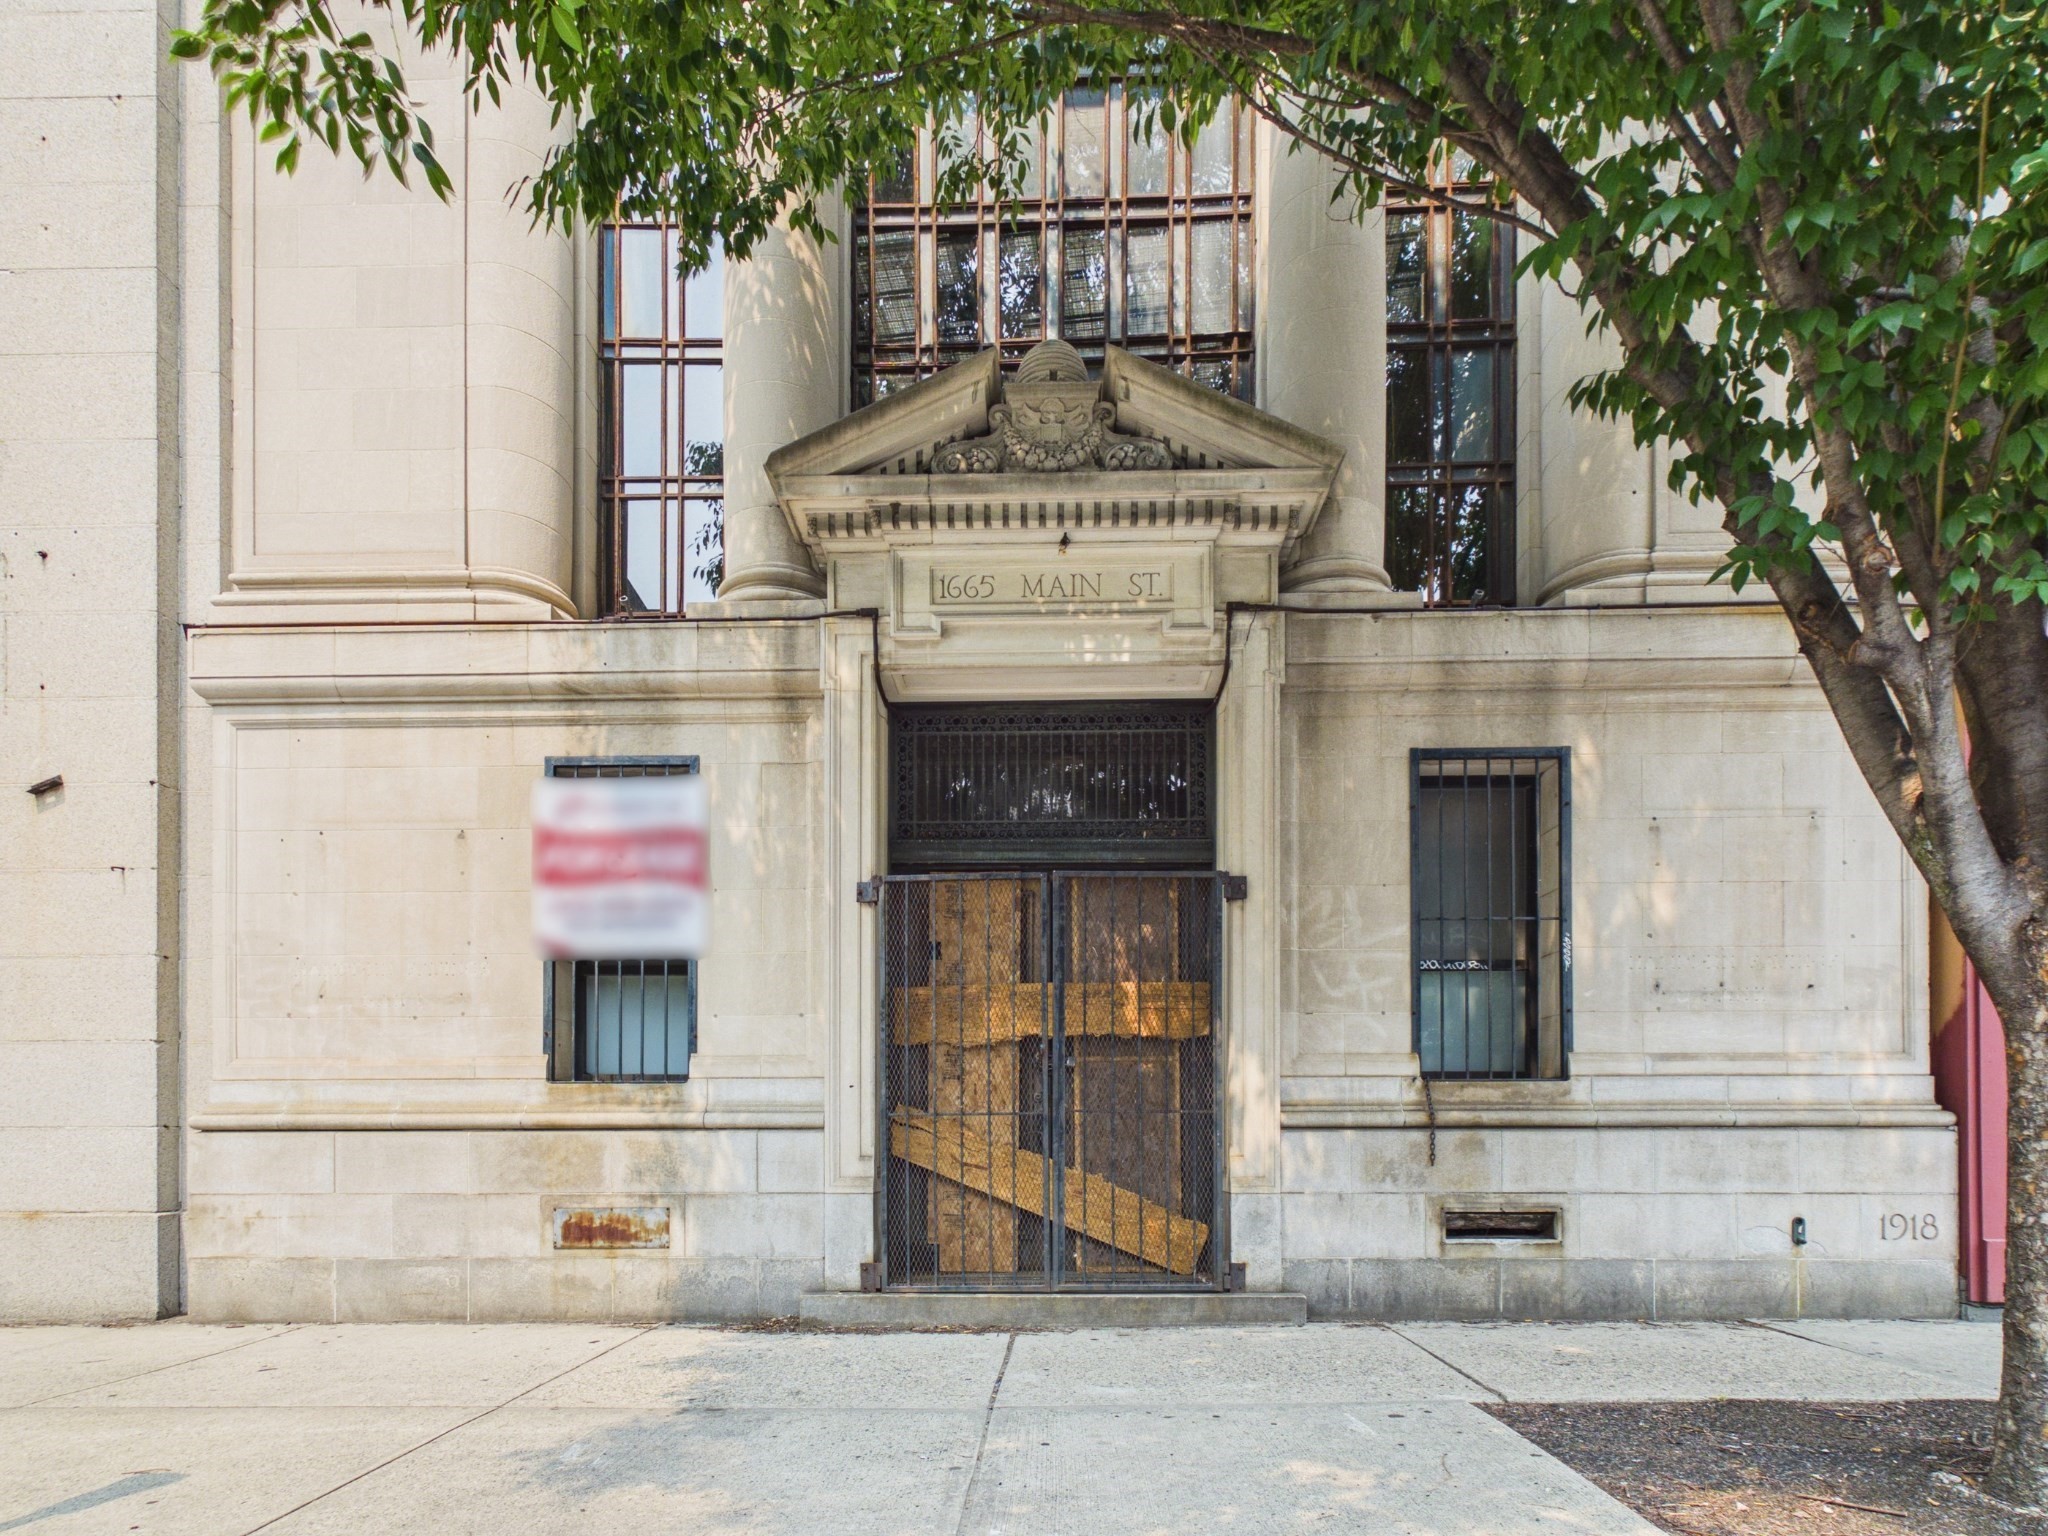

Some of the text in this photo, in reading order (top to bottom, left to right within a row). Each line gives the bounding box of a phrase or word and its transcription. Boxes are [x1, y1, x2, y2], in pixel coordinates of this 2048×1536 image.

[939, 572, 1163, 599] 1665 MAIN ST.
[1880, 1213, 1939, 1241] 1918
